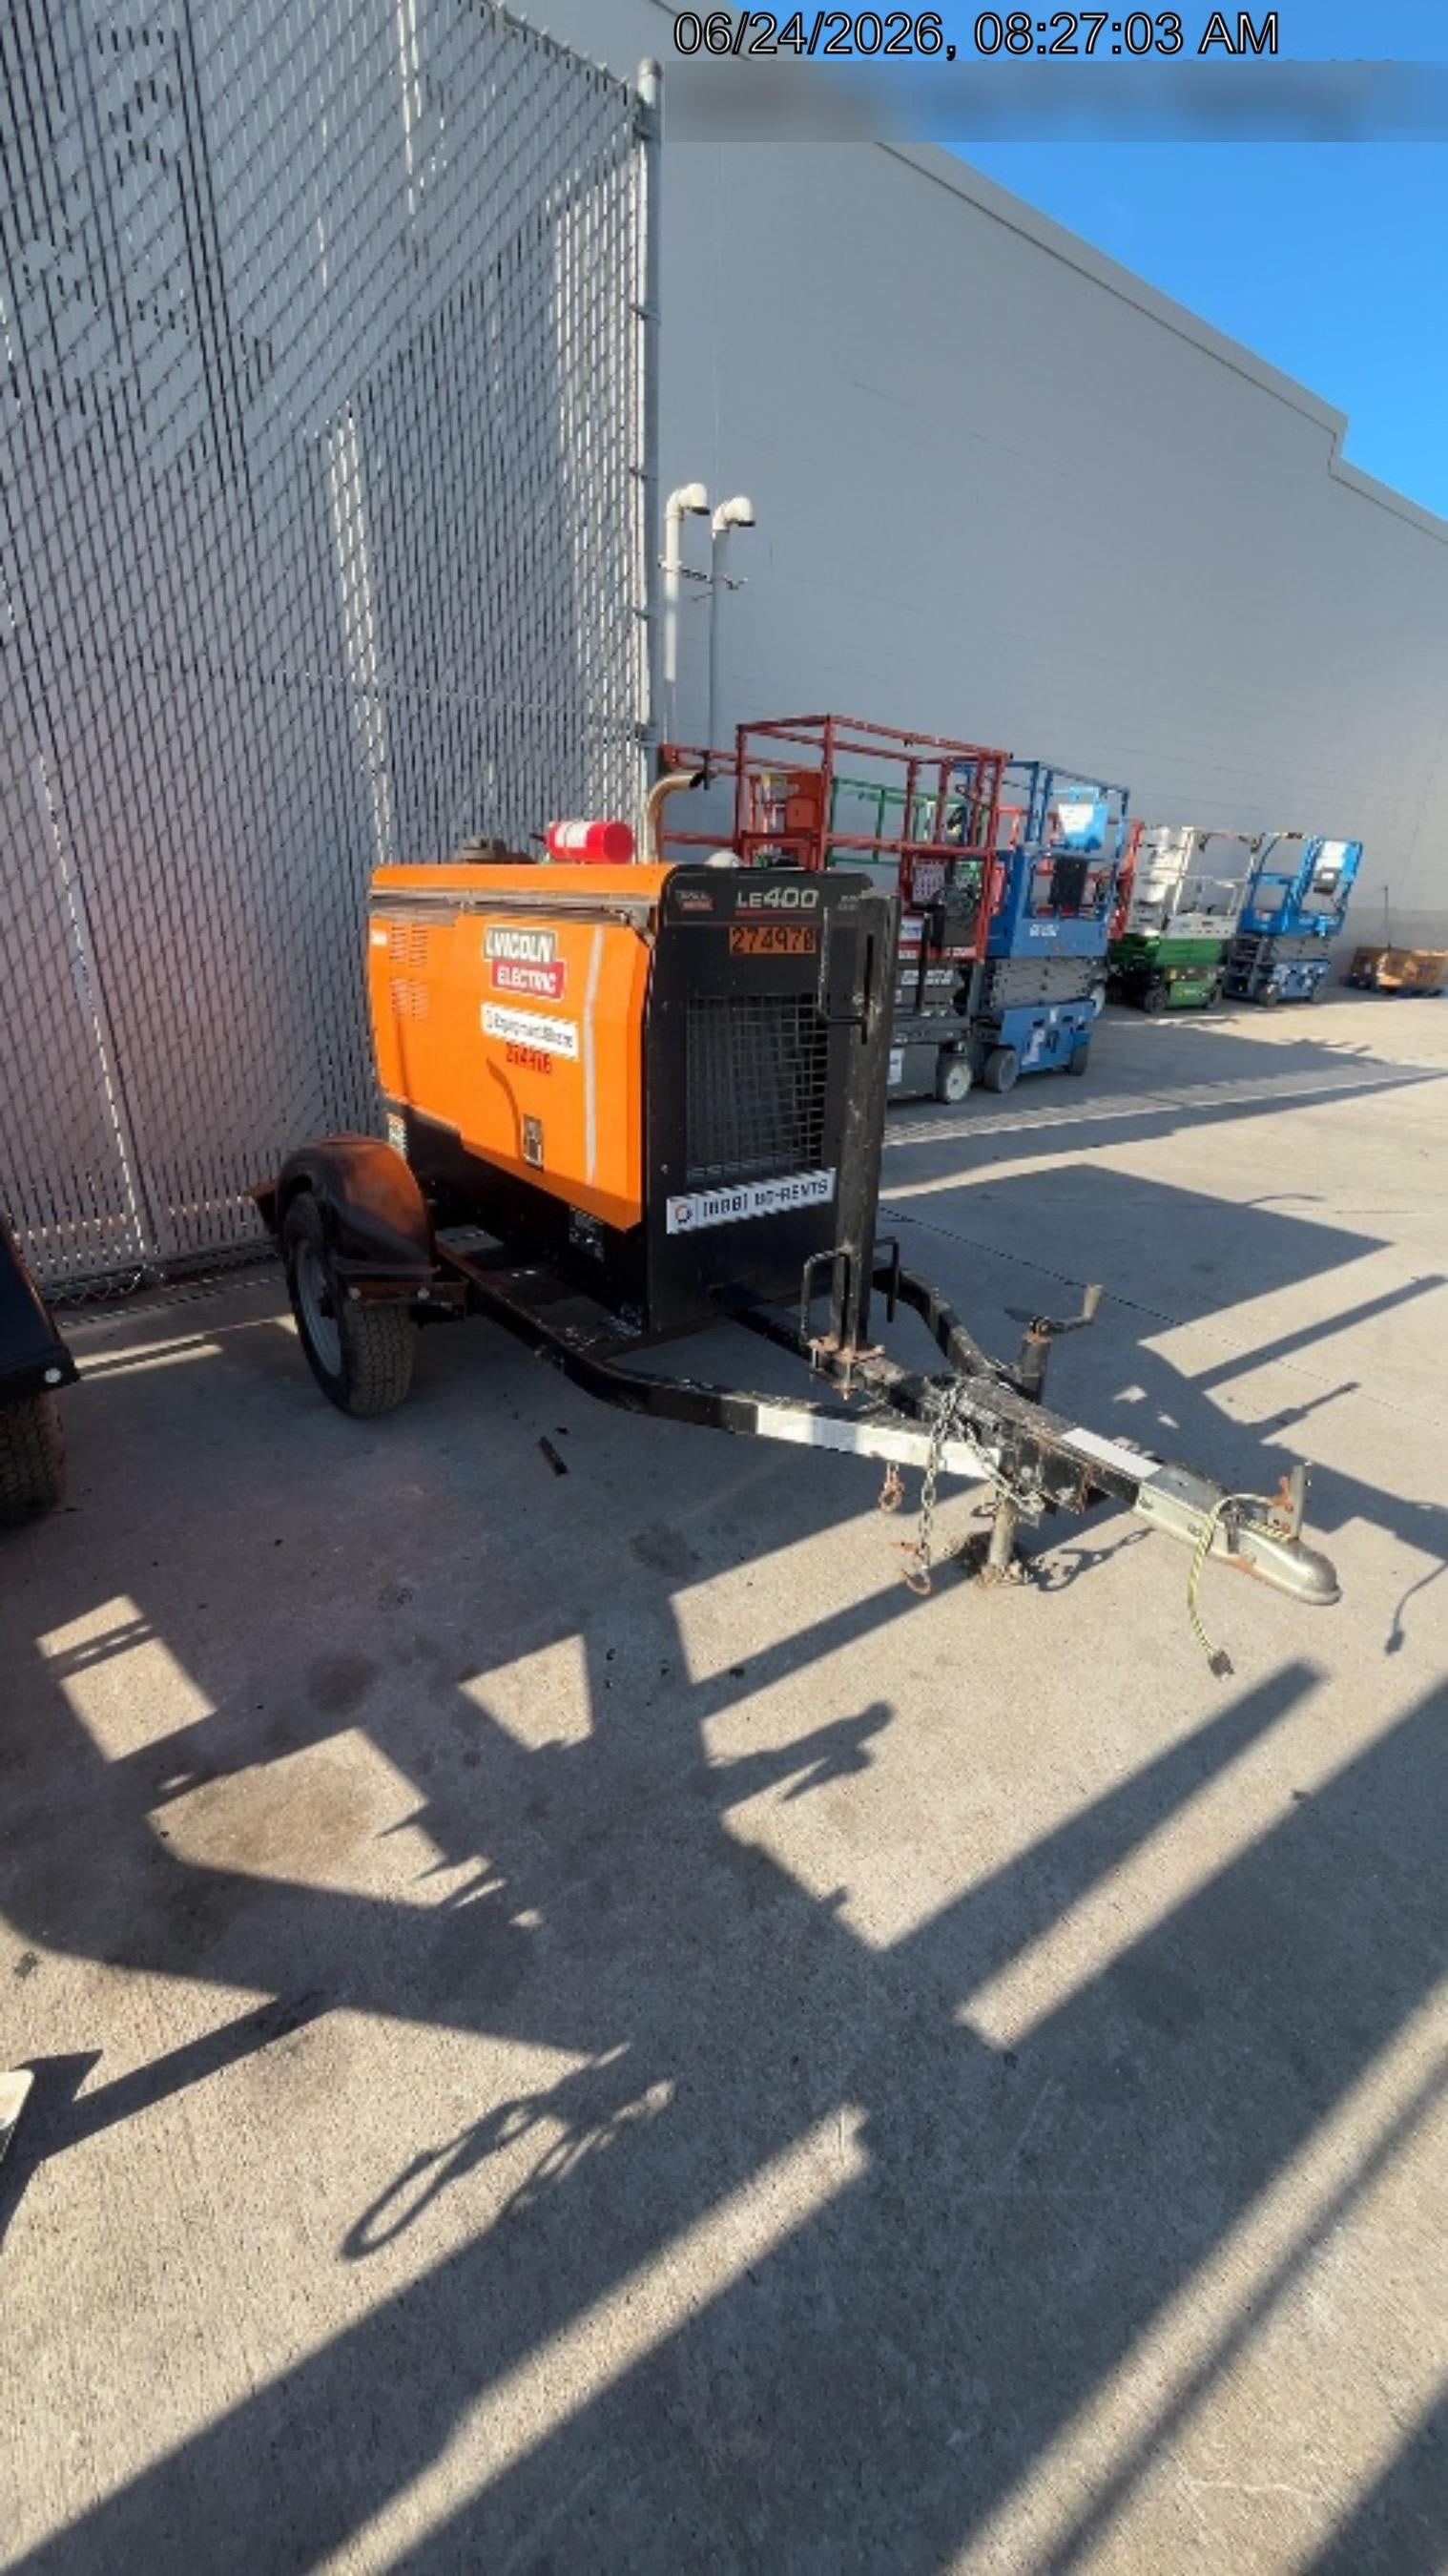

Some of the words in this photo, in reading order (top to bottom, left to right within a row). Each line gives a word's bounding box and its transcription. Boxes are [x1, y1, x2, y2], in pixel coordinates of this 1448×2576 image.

[736, 886, 819, 909] LE400
[486, 929, 553, 964] LINCOLN
[496, 966, 557, 995] ELECTRIC
